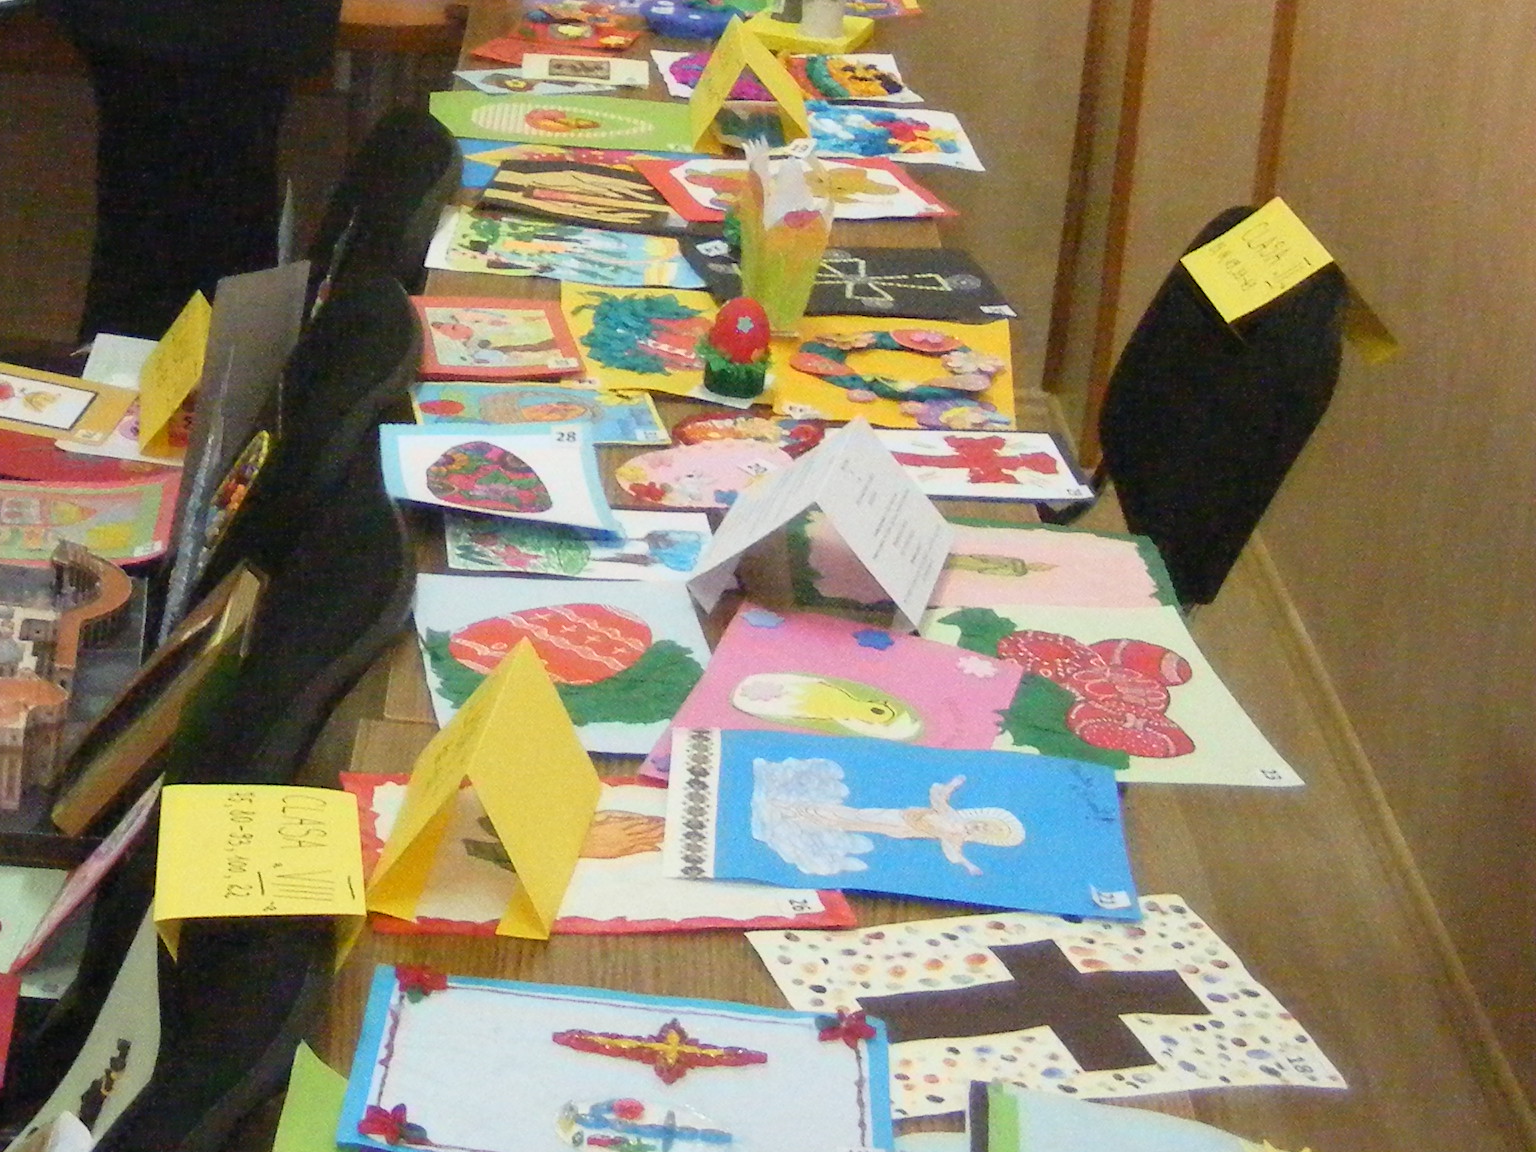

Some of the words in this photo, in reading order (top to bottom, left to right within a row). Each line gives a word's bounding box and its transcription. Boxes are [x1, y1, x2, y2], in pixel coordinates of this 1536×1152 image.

[555, 431, 577, 443] 28
[278, 795, 327, 849] CLASA
[1285, 1056, 1314, 1074] 18
